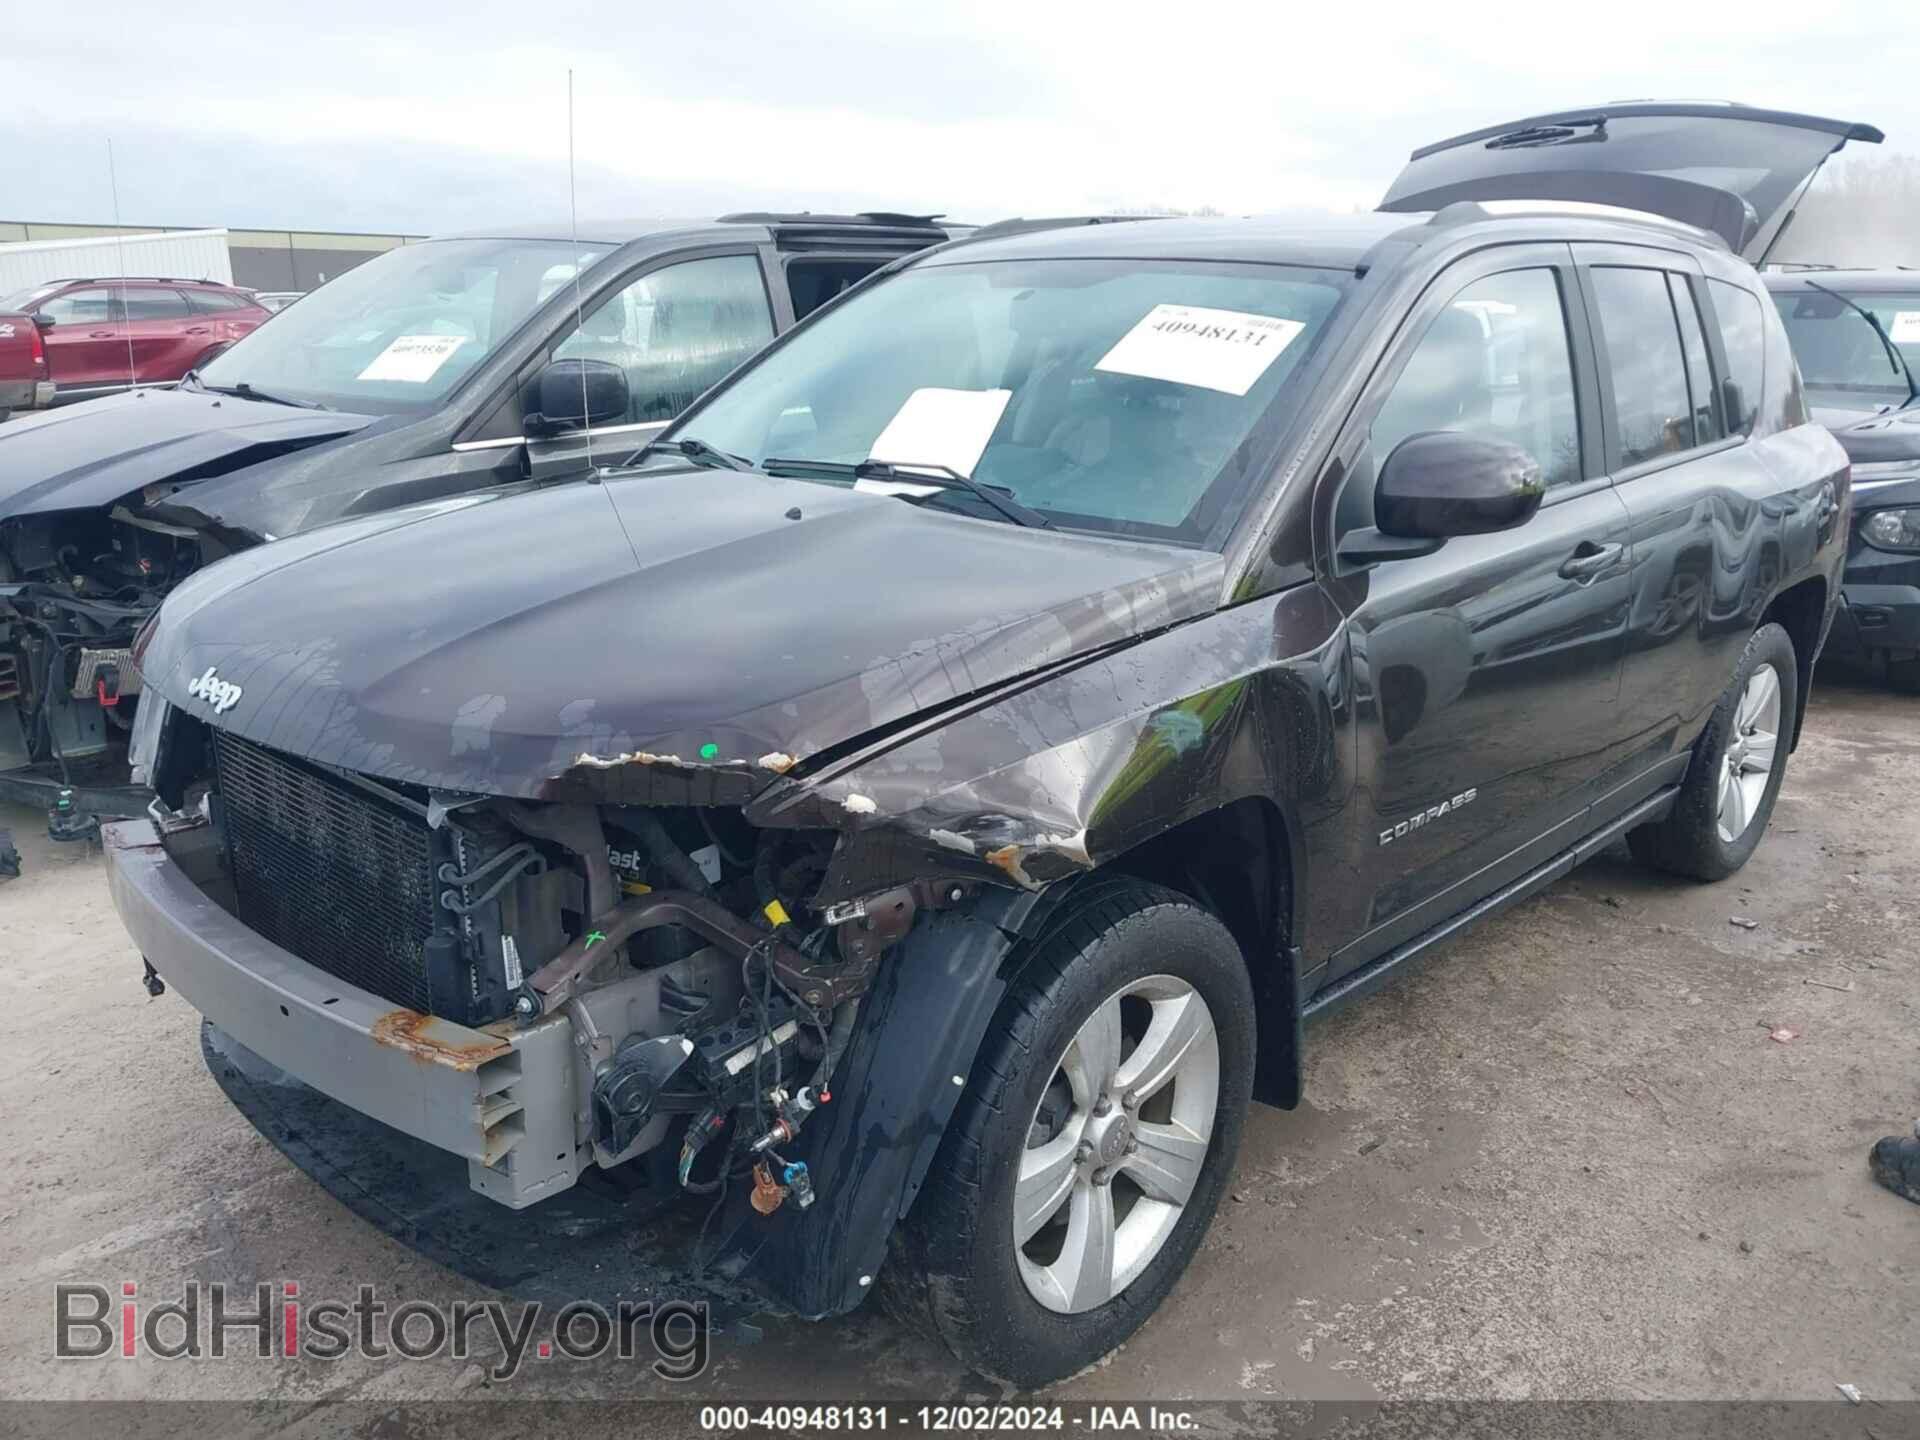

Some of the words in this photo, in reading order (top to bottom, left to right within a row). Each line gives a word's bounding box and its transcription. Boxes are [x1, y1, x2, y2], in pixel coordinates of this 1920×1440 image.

[1152, 320, 1269, 347] 40948131
[188, 666, 243, 715] Jeep
[1379, 787, 1478, 846] COMPASS
